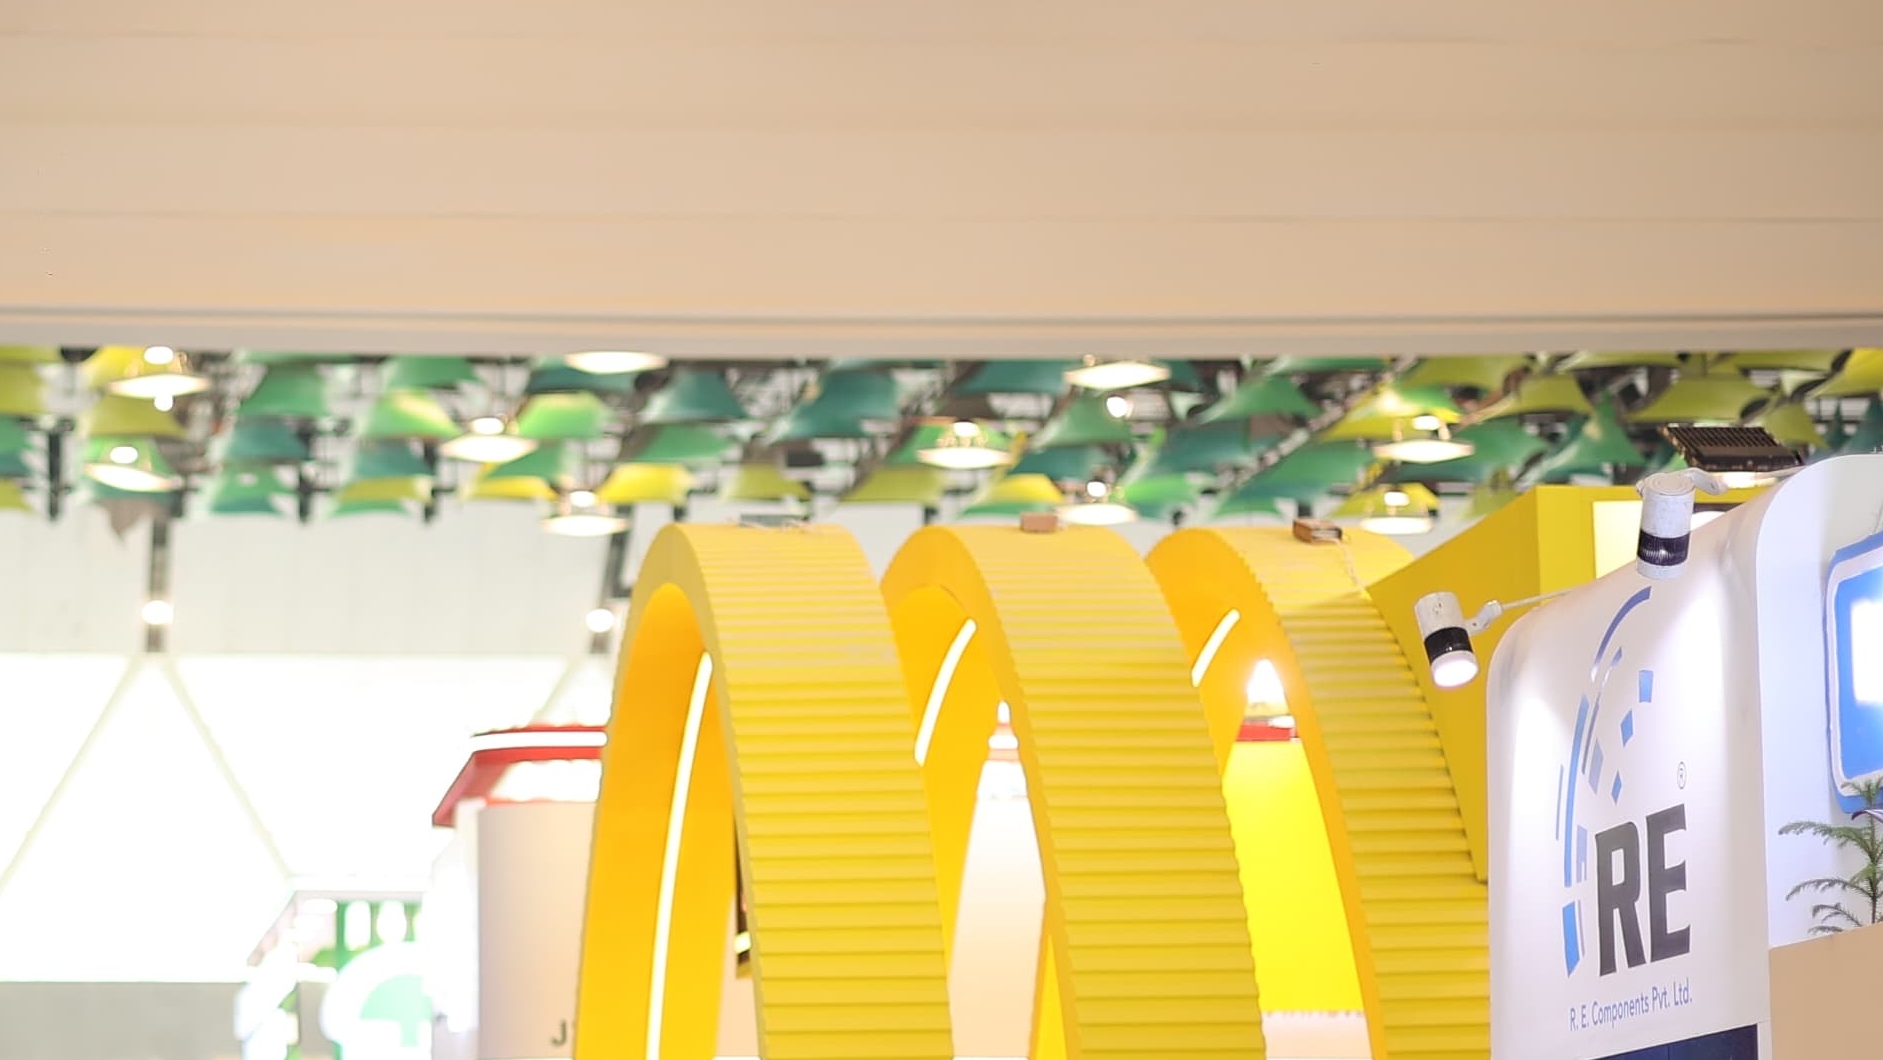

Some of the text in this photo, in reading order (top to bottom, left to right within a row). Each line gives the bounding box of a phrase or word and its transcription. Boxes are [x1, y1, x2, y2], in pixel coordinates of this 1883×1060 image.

[1595, 804, 1691, 977] RE
[1570, 977, 1693, 1031] R. E. Components Pvt. Ltd.
